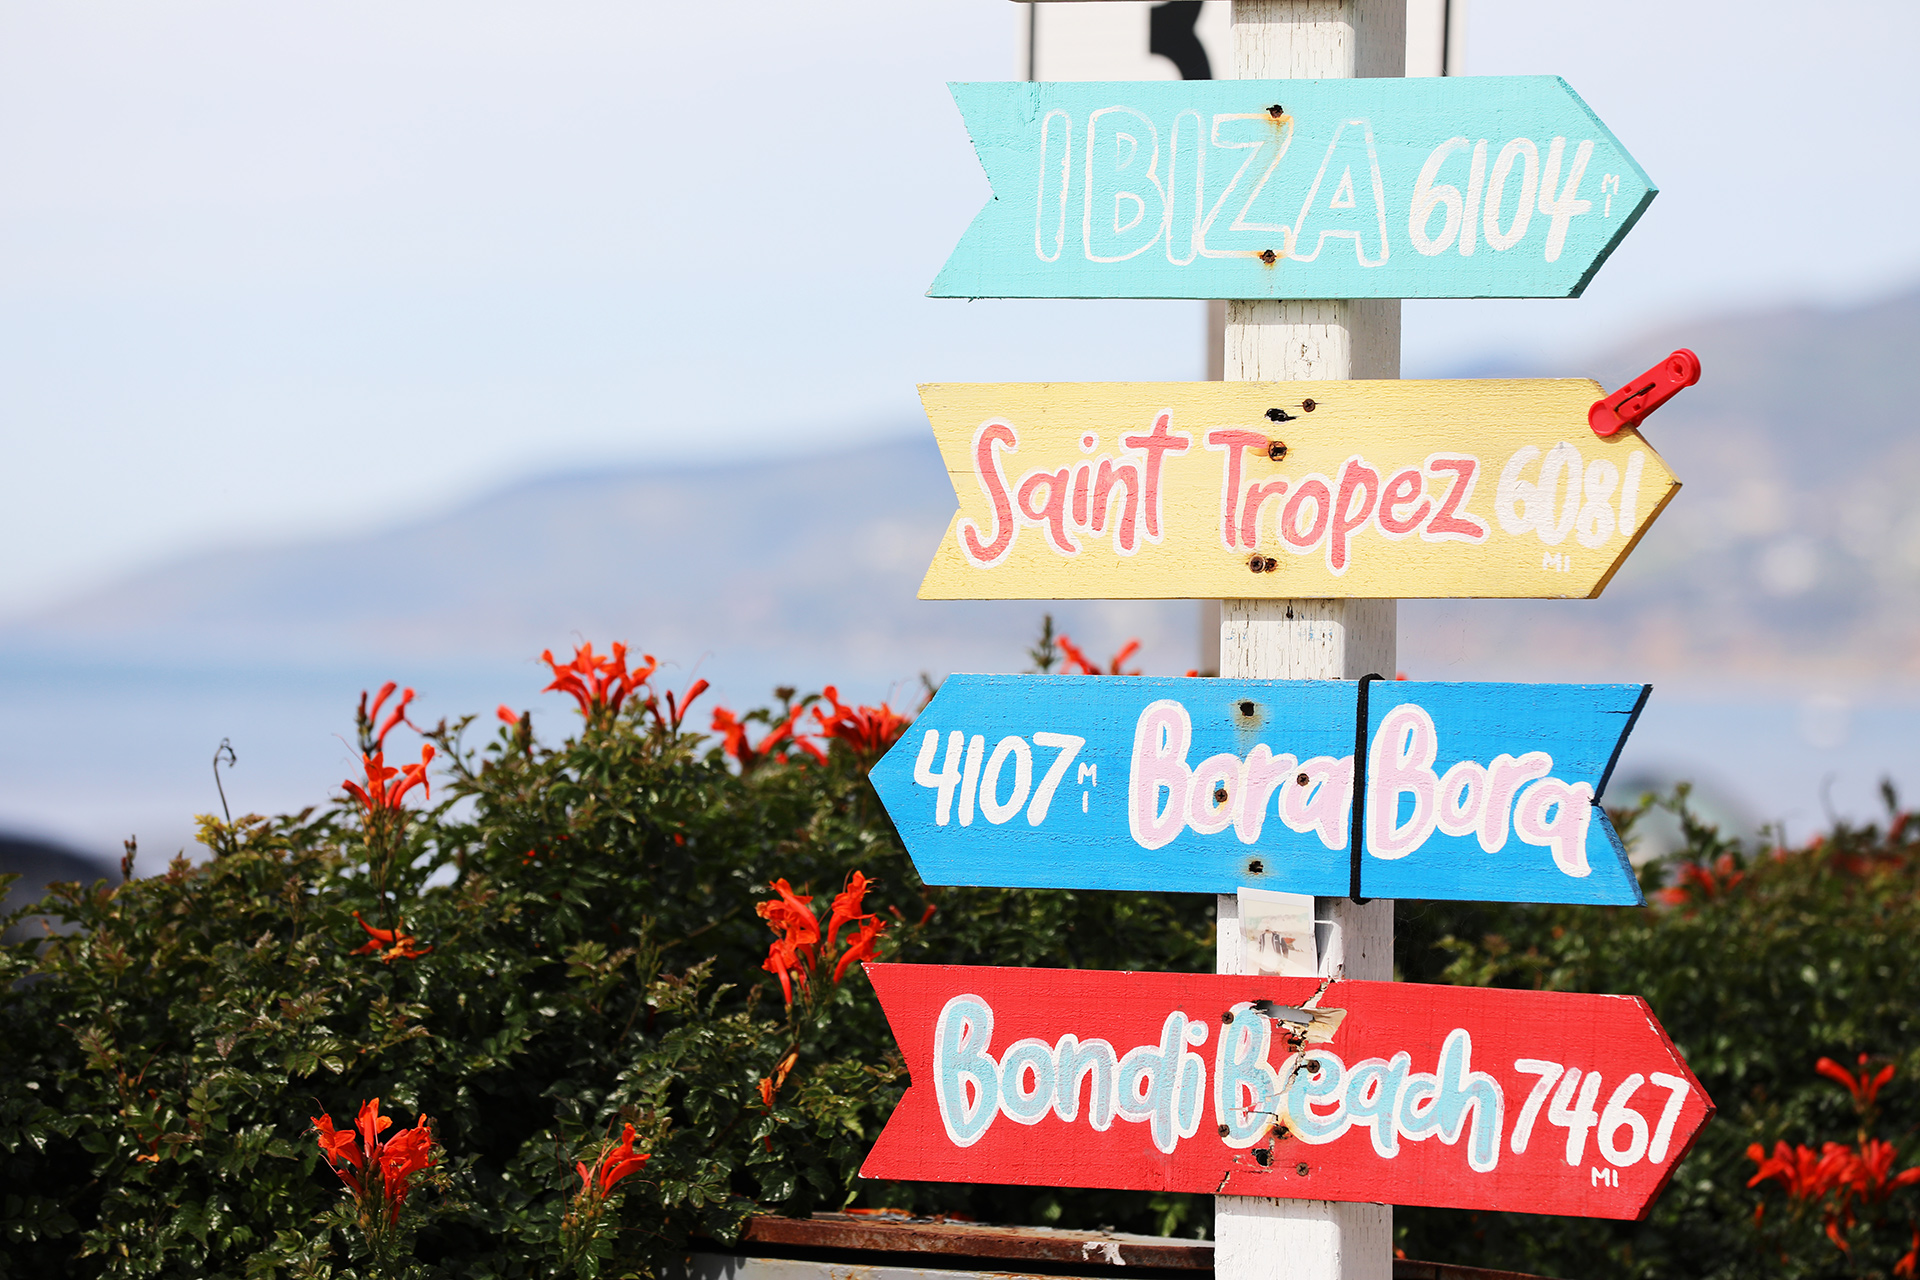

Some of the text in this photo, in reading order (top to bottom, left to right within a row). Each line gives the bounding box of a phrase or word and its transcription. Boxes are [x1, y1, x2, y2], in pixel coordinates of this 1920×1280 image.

[1034, 105, 1594, 268] IBIZA 6104
[956, 407, 1644, 576] Saint Tropez 6081
[1542, 553, 1570, 573] MI
[913, 699, 1597, 878] 4107 Bora Bora
[932, 993, 1690, 1173] Bondi Beach 7467
[1590, 1167, 1619, 1188] MI
